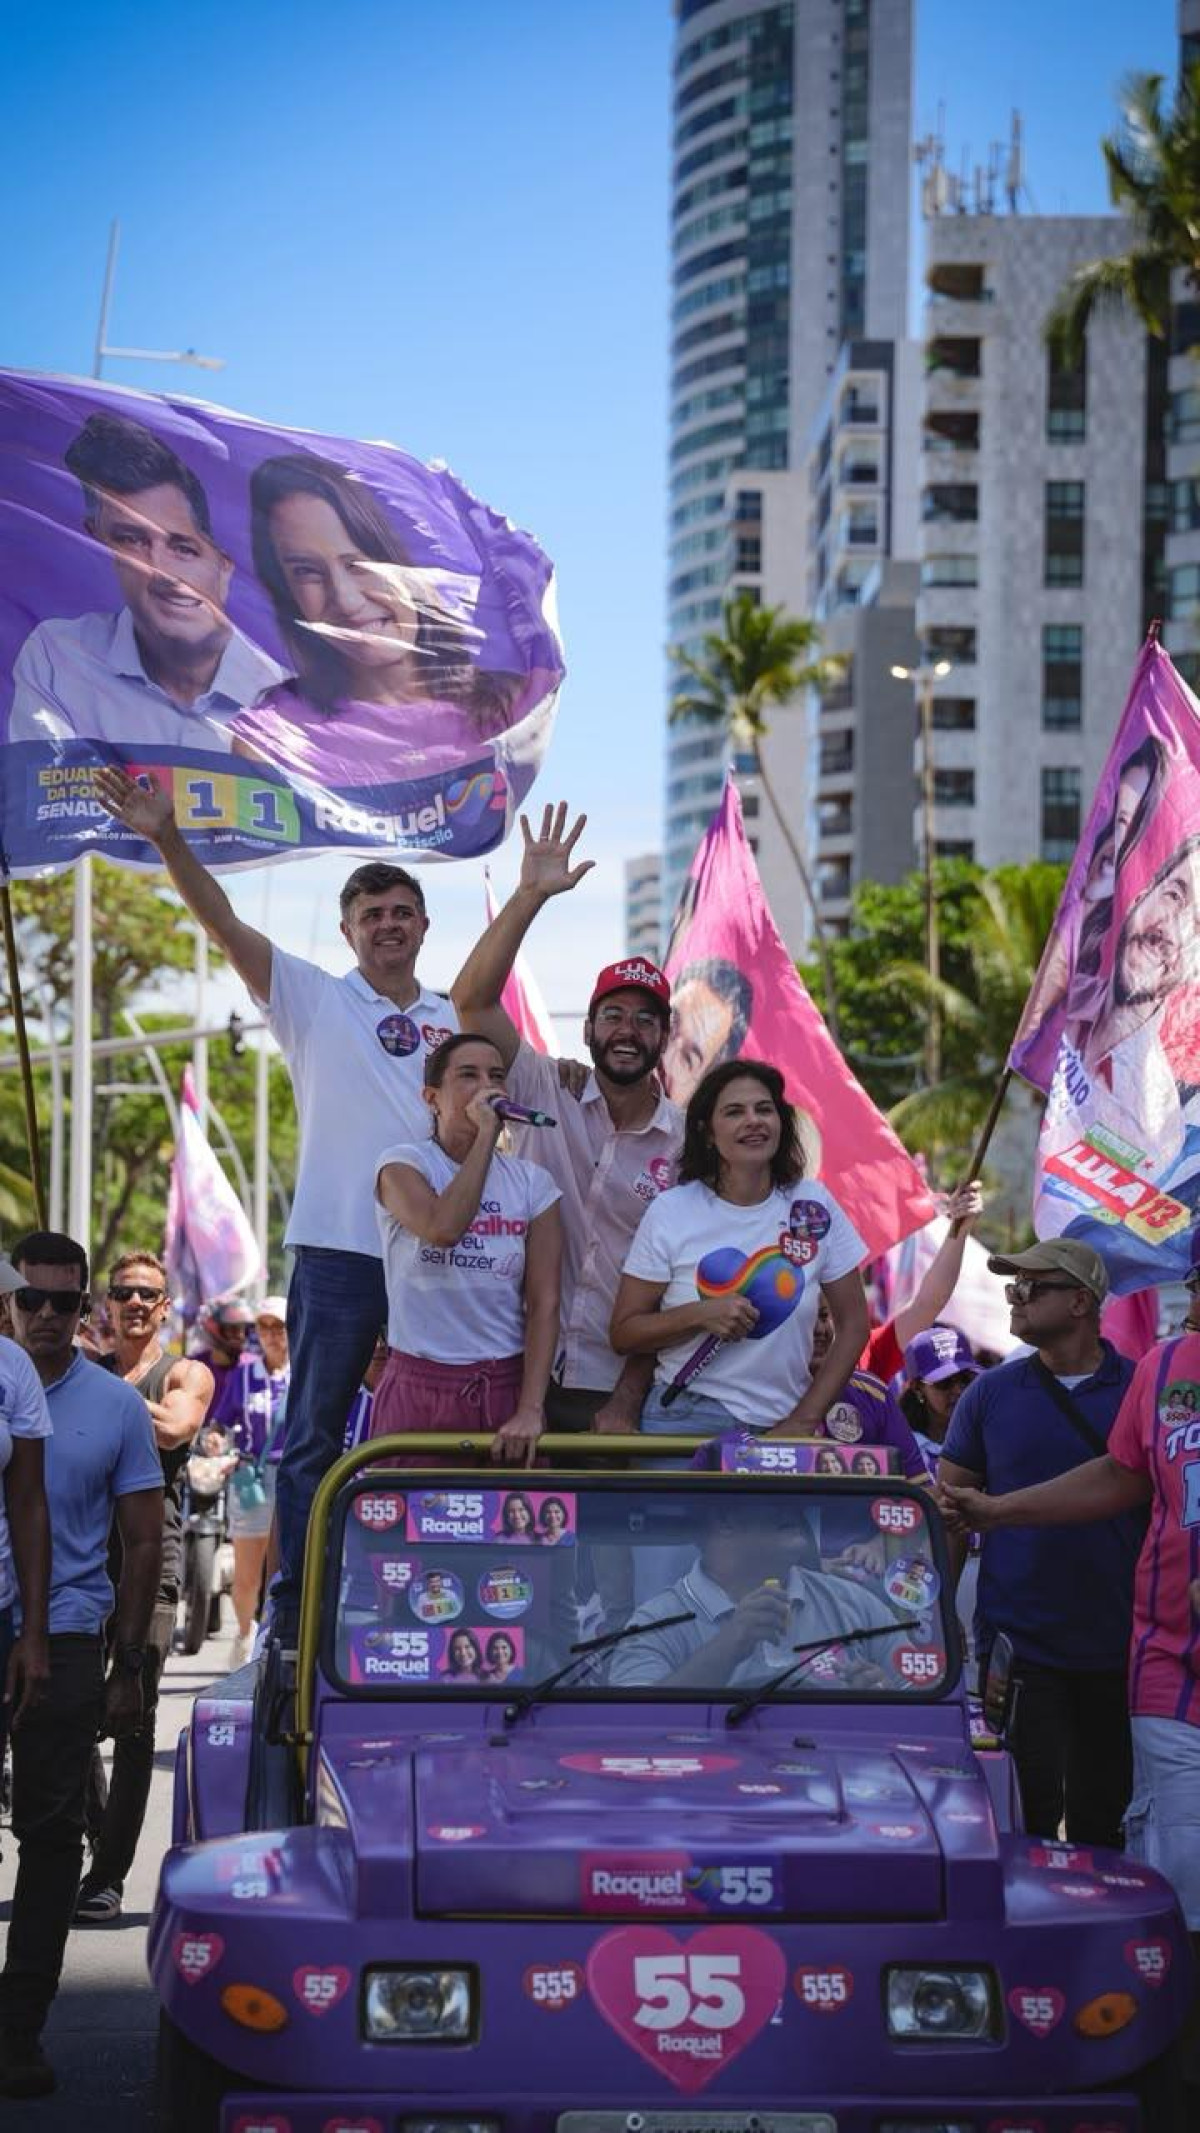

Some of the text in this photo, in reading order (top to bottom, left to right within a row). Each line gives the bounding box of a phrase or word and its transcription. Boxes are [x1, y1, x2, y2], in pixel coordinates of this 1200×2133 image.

[47, 787, 66, 800] DA
[314, 793, 446, 842] Raquel
[1057, 1144, 1146, 1208] LULA
[1138, 1198, 1183, 1229] 13
[461, 1236, 485, 1251] eu
[783, 1235, 812, 1260] 555
[420, 1248, 498, 1270] sei fazer
[760, 1447, 797, 1469] 55
[361, 1498, 398, 1522] 555
[447, 1494, 484, 1519] 55
[879, 1504, 916, 1529] 555
[421, 1517, 484, 1537] Raquel
[382, 1562, 411, 1582] 55
[390, 1632, 429, 1658] 55
[365, 1657, 429, 1677] Raquel
[900, 1652, 939, 1676] 555
[592, 1866, 774, 1905] Raquel 55
[181, 1942, 211, 1968] 55
[1135, 1946, 1164, 1971] 55
[303, 1974, 338, 2000] 55
[531, 1970, 577, 2000] 555
[633, 1954, 746, 2030] 55
[802, 1973, 847, 2002] 555
[1021, 1996, 1054, 2021] 55
[657, 2033, 723, 2058] Raquel
